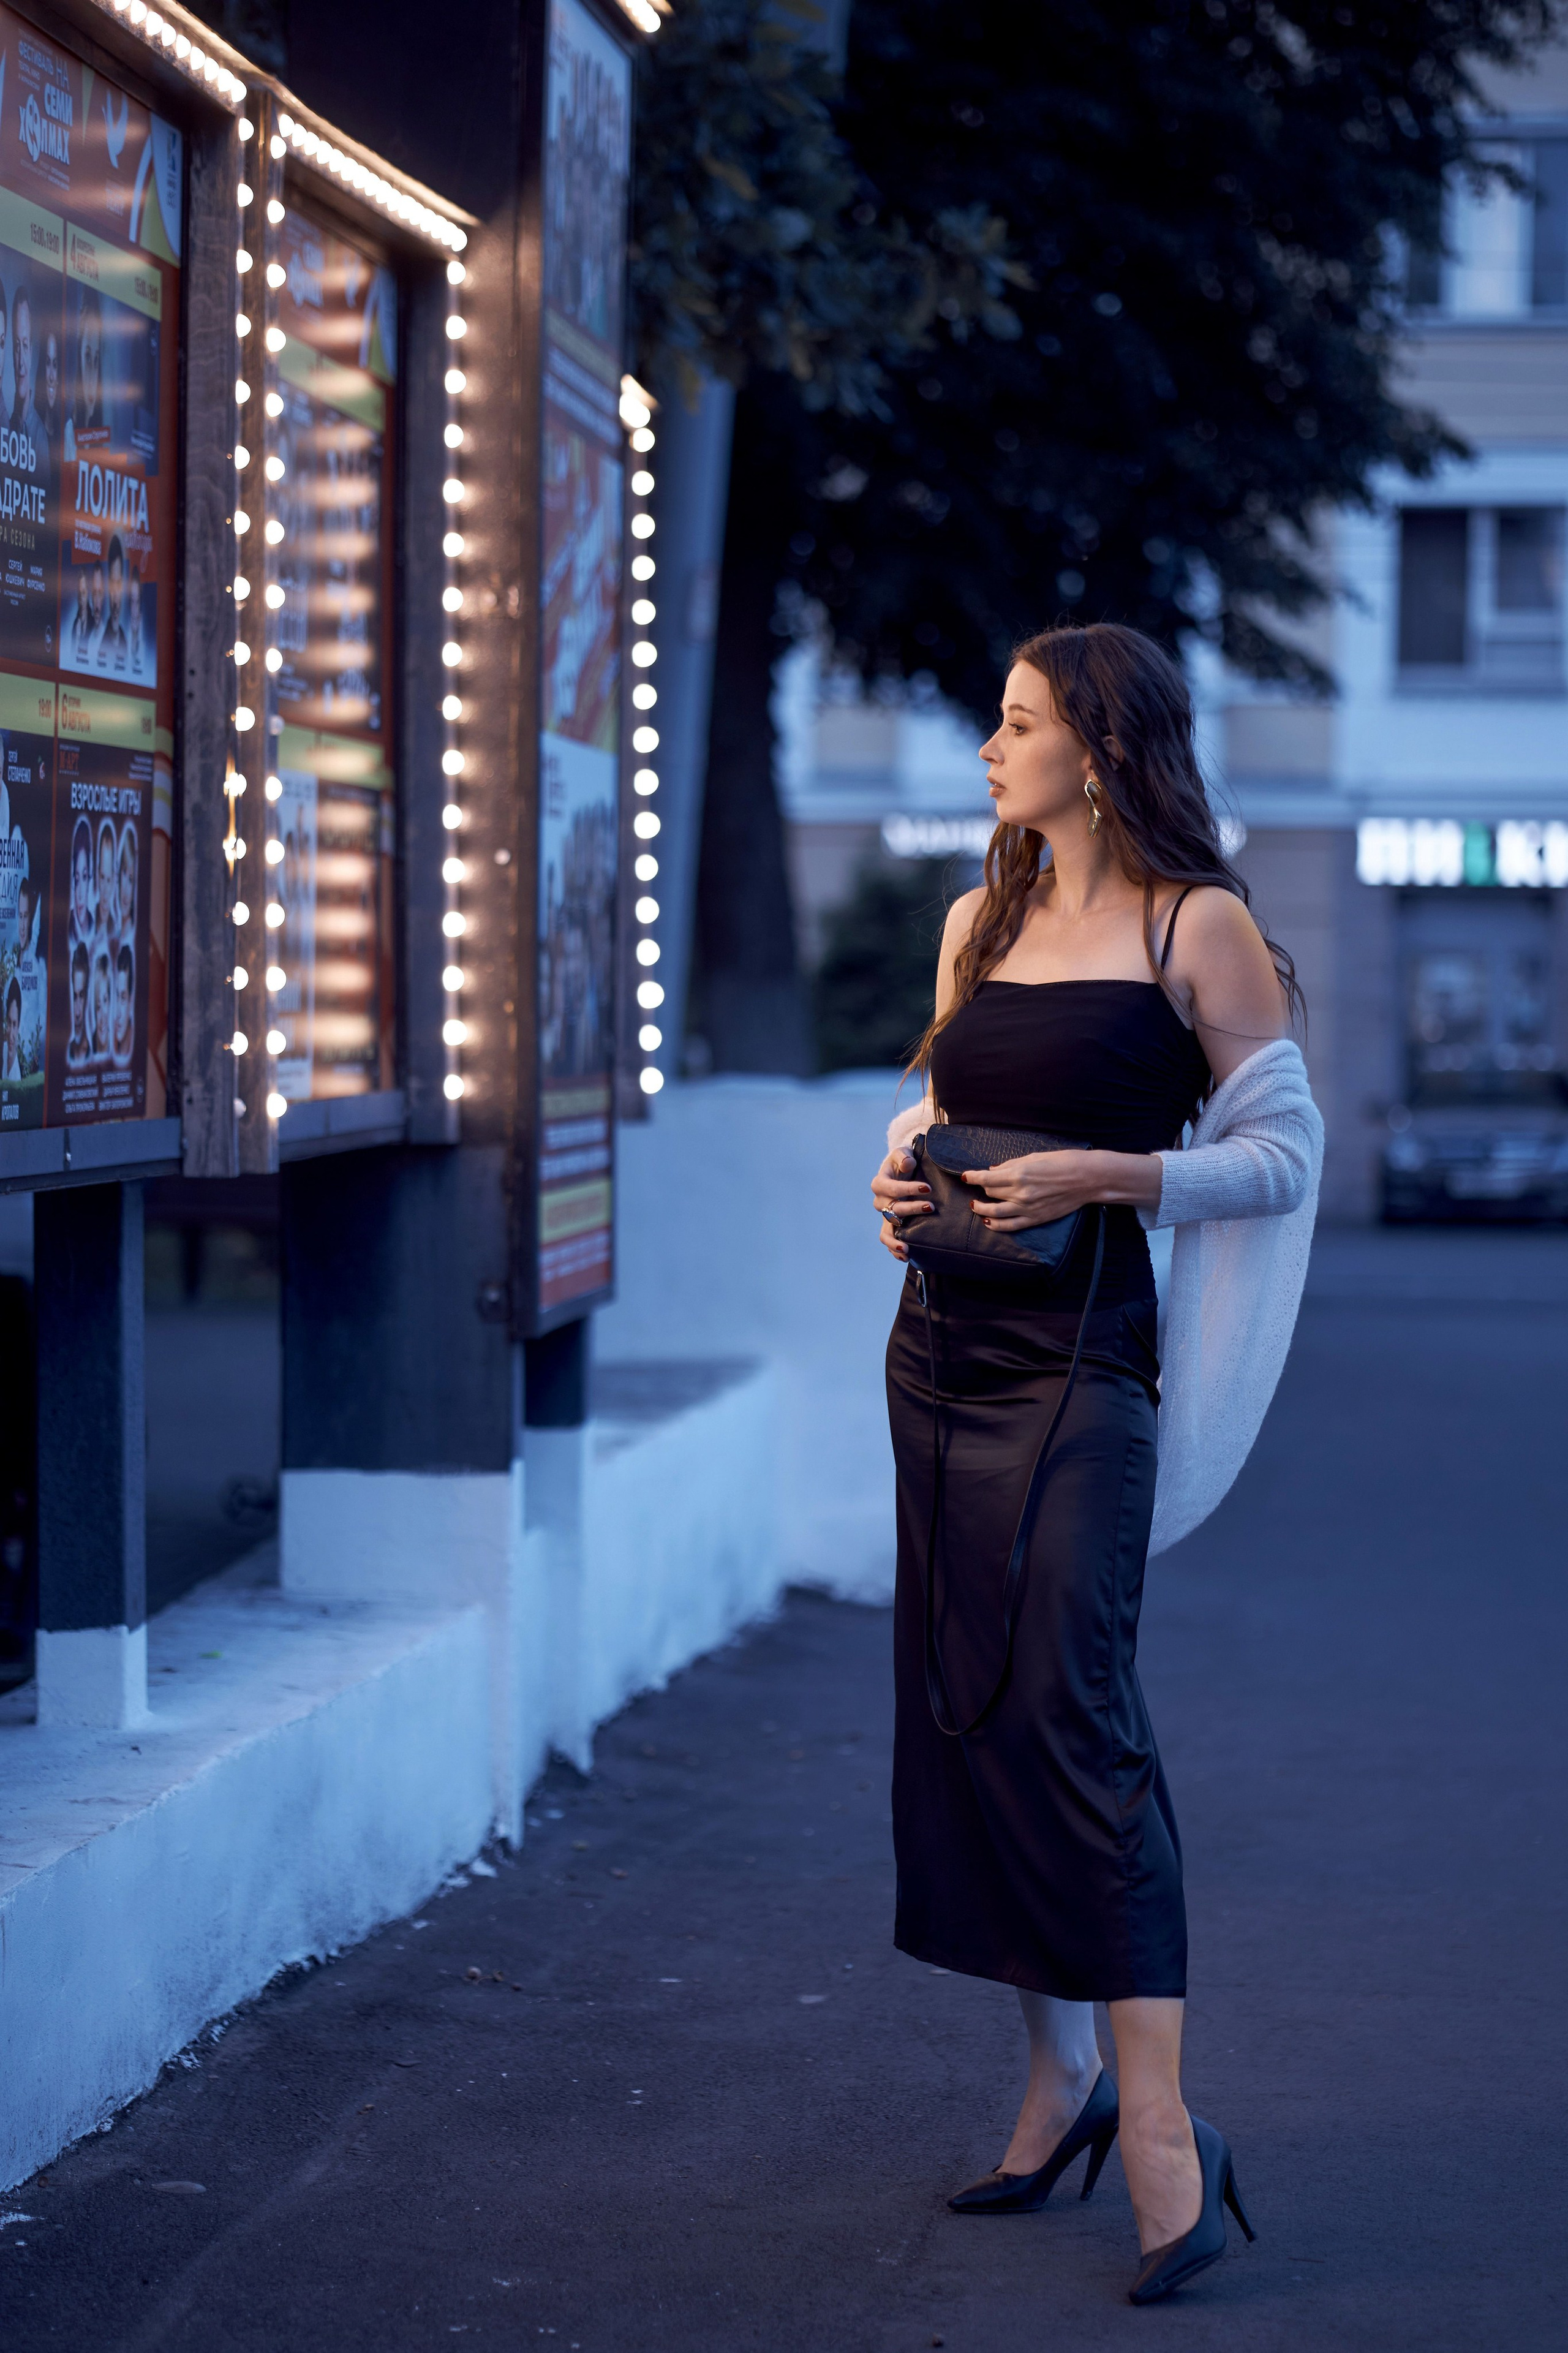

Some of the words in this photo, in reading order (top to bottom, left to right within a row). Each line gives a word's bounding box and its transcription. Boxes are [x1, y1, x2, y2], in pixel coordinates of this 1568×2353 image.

[18, 40, 54, 75] ФЕСТИВАЛЬ
[55, 56, 70, 91] НА
[44, 83, 73, 127] СЕМИ
[0, 426, 36, 472] БОВЬ
[75, 459, 149, 534] ЛОЛИТА
[10, 527, 36, 551] СЕЗОНА
[9, 559, 23, 572] СЕРГЕЙ
[62, 693, 67, 730] 6
[71, 782, 118, 814] ВЗРОСЛЫЕ
[118, 787, 141, 816] ИГРЫ
